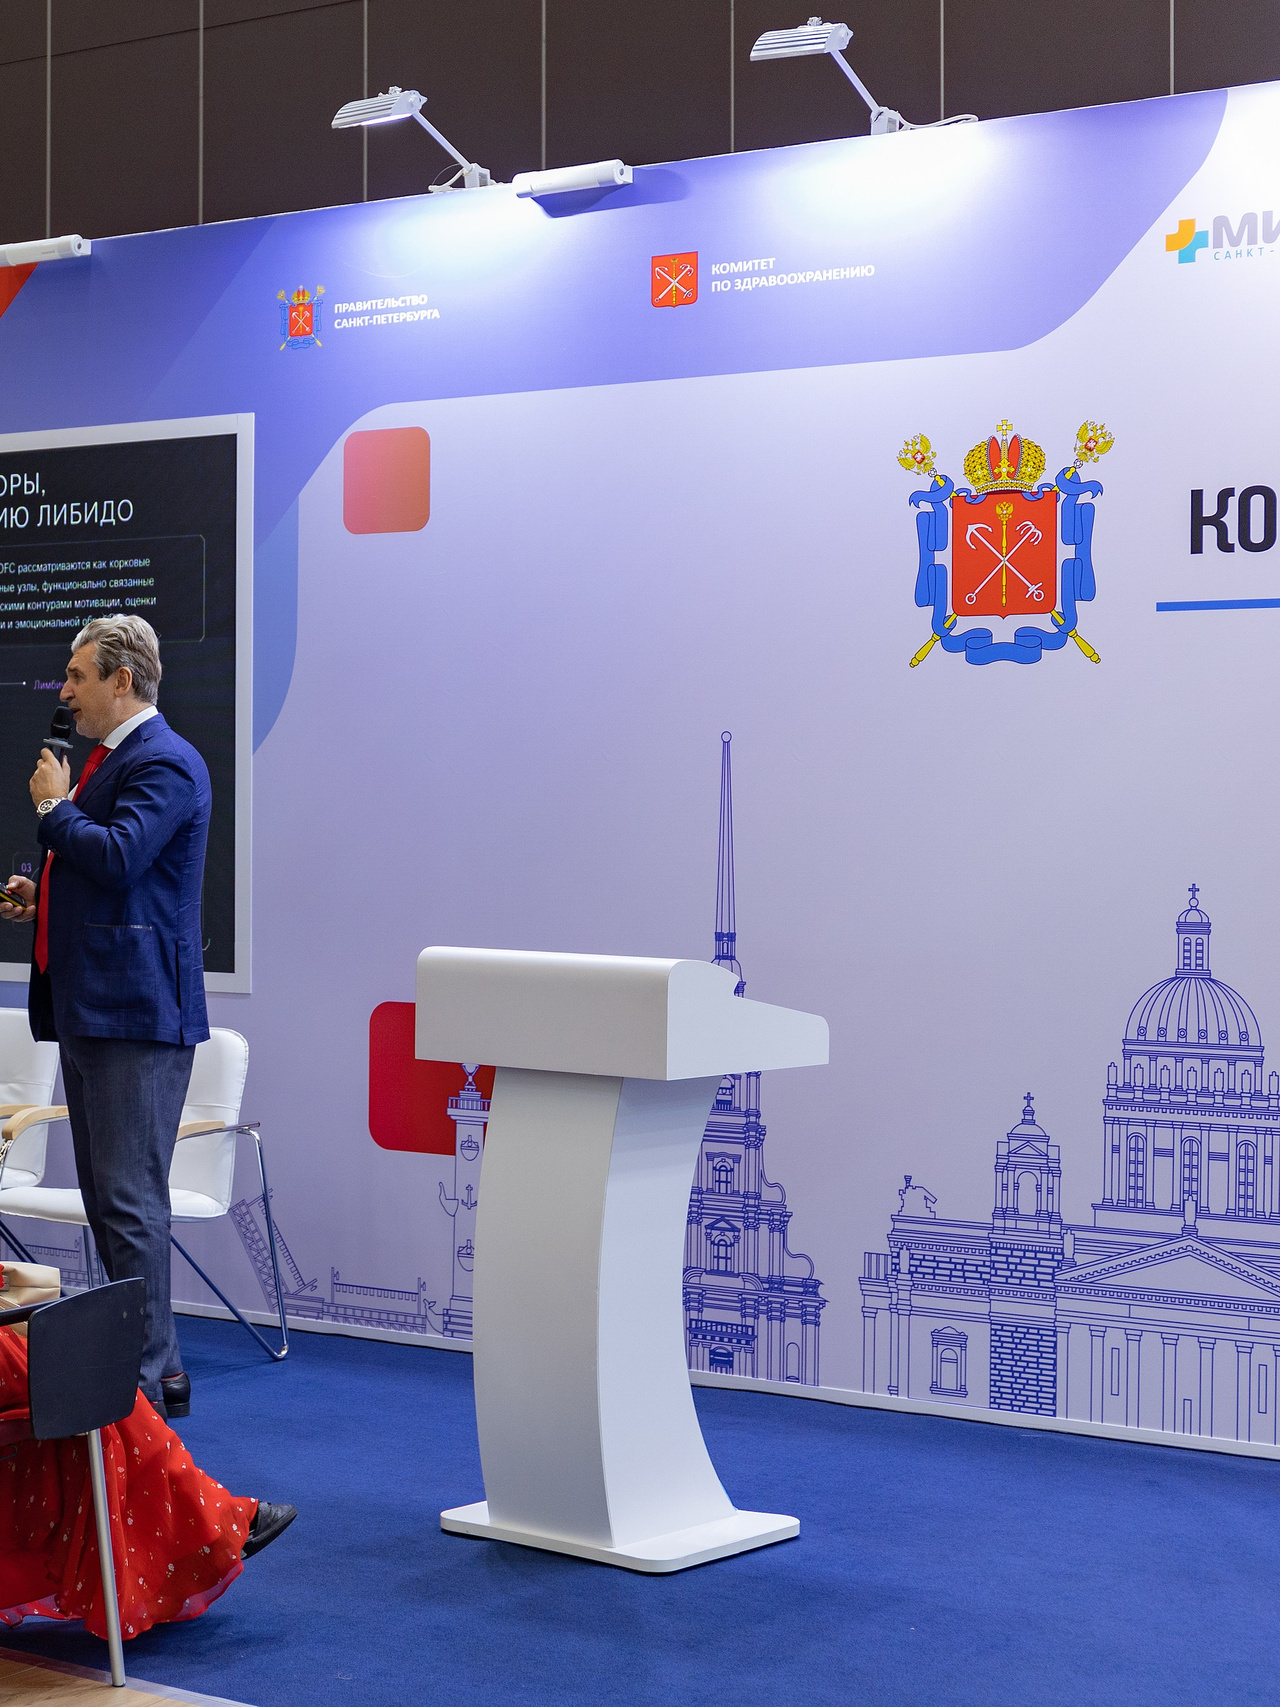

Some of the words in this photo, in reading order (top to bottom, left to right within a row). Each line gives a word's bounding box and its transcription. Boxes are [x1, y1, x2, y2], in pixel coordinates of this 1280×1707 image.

[712, 257, 776, 275] КОМИТЕТ
[712, 280, 731, 292] ПО
[734, 264, 875, 292] ЗДРАВООХРАНЕНИЮ
[334, 294, 428, 314] ПРАВИТЕЛЬСТВО
[334, 309, 440, 329] САНКТ-ПЕТЕРБУРГА
[36, 499, 134, 527] ЛИБИДО
[1190, 485, 1277, 554] КО
[17, 560, 91, 575] рассматриваются
[92, 560, 107, 569] как
[109, 557, 151, 571] корковые
[41, 577, 107, 593] функционально
[108, 577, 155, 588] связанные
[27, 600, 72, 612] контурами
[74, 597, 123, 608] мотивации,
[125, 596, 157, 607] оценки
[7, 621, 13, 629] и
[14, 616, 80, 631] эмоциональной
[21, 862, 32, 873] 03
